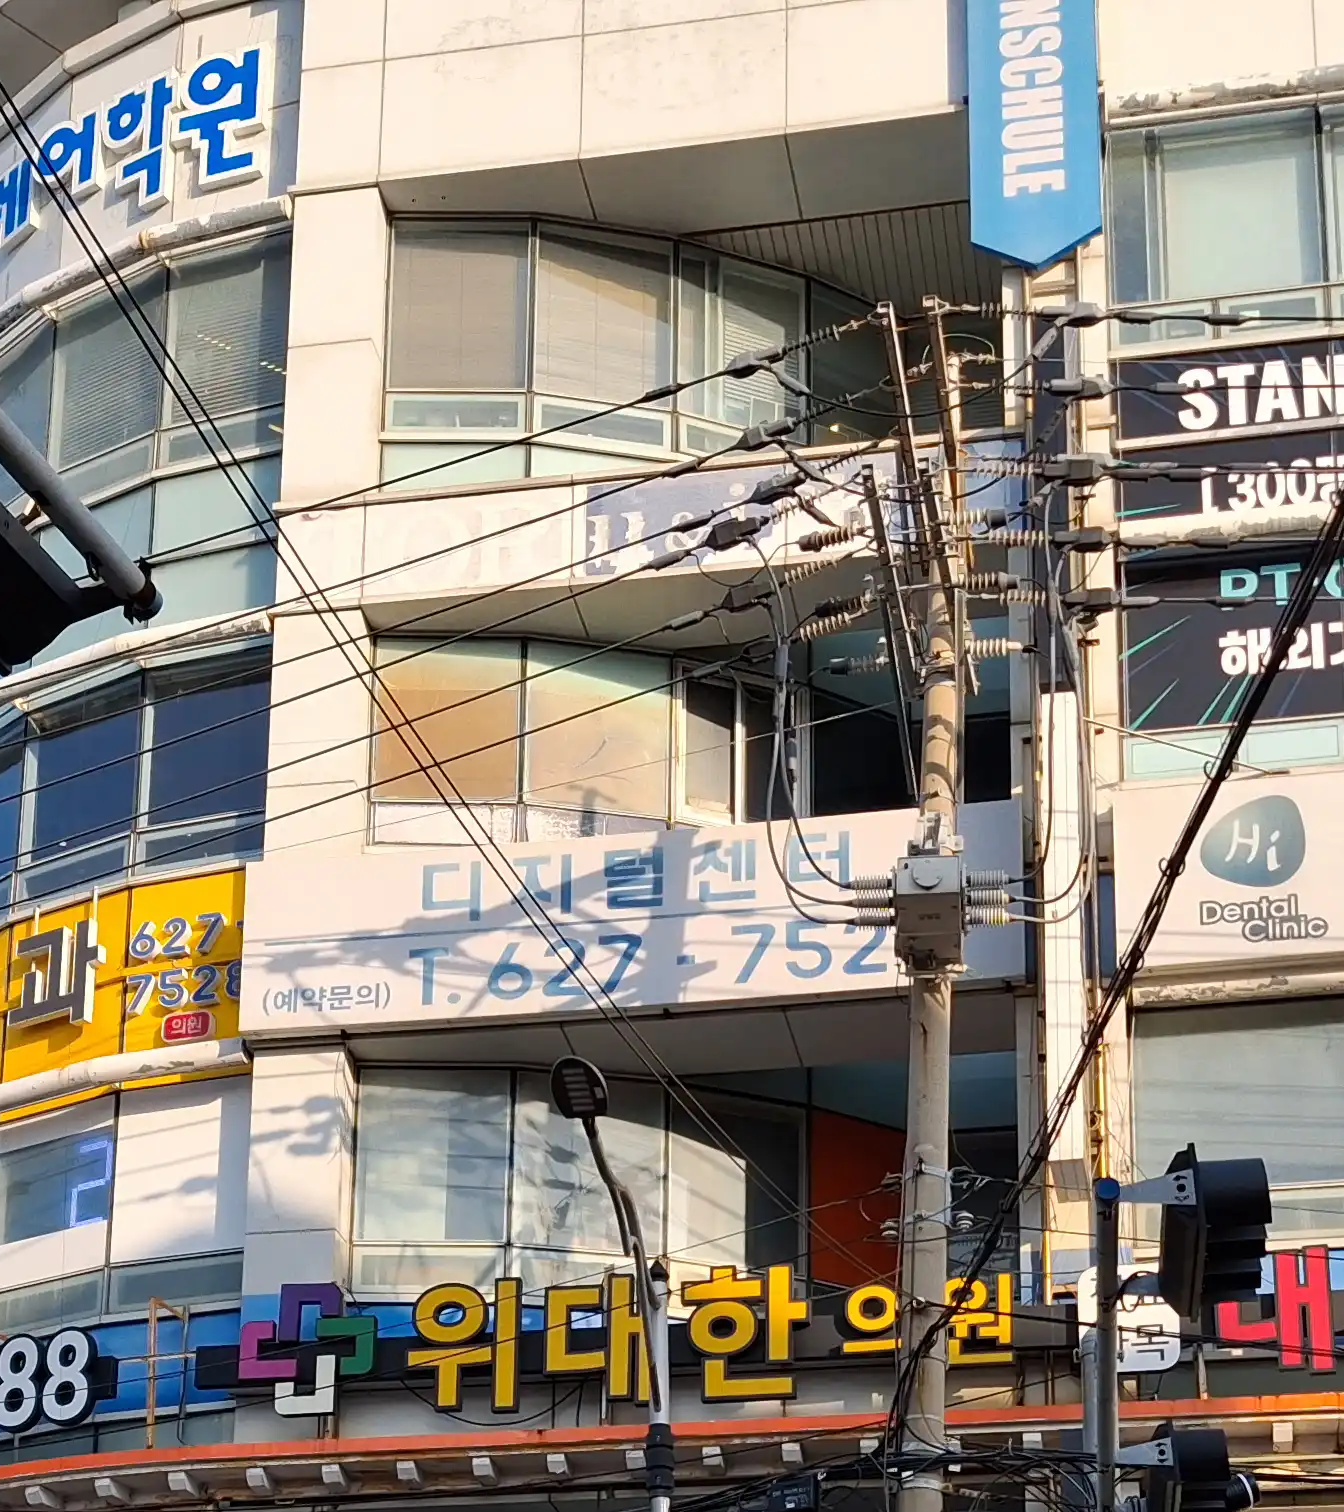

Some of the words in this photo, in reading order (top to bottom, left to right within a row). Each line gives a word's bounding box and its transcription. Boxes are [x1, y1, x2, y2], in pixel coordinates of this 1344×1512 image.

[1224, 821, 1282, 871] Hi
[422, 830, 853, 921] 디지털센터
[1198, 894, 1298, 927] Dental
[1242, 912, 1329, 943] Clinic
[261, 980, 392, 1017] (예약문의)
[169, 1014, 204, 1037] 의원
